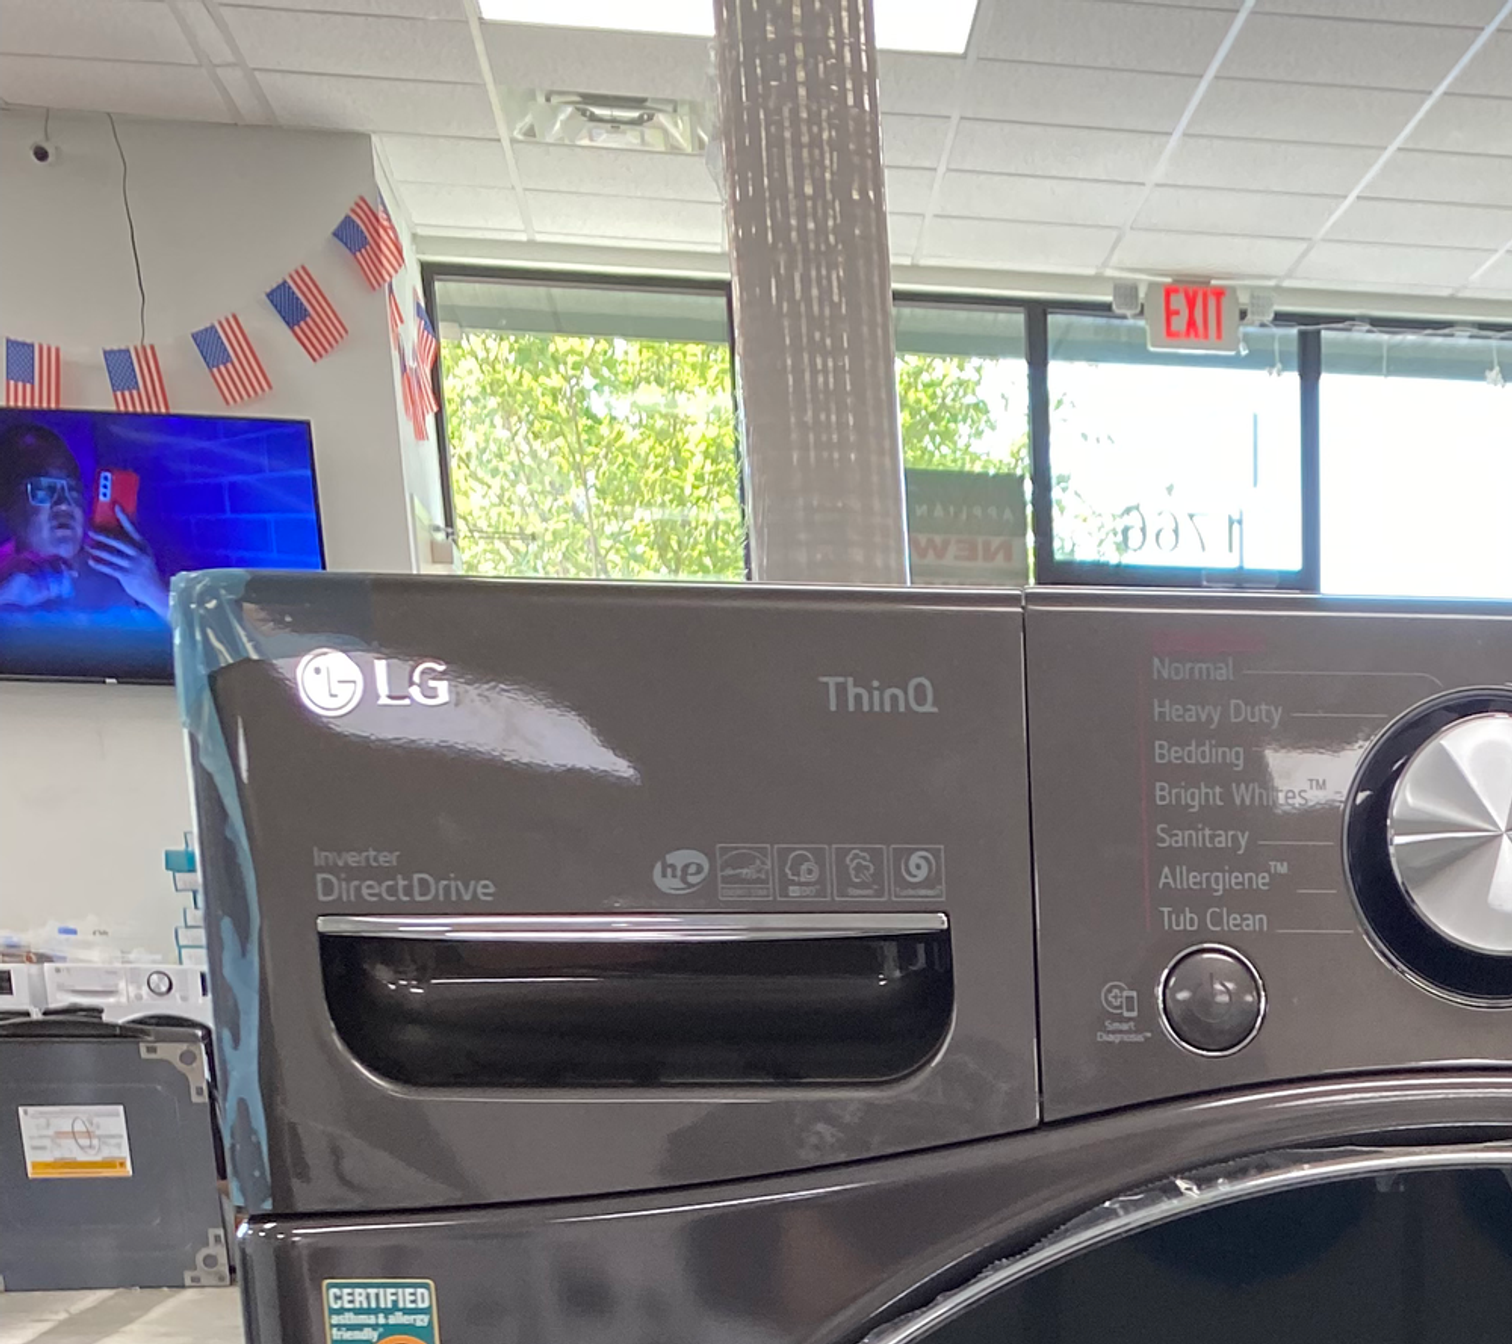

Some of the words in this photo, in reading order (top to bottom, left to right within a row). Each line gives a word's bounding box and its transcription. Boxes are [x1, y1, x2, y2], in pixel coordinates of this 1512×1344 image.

[1163, 285, 1226, 341] EXIT
[373, 655, 450, 706] LG
[1152, 657, 1234, 681] Normal
[818, 676, 939, 713] ThinQ
[1153, 699, 1221, 727] Heavy
[1230, 700, 1283, 727] Duty
[1154, 741, 1244, 768] Bedding
[1155, 783, 1223, 811] Bright
[1156, 825, 1249, 854] Sanitary
[313, 846, 401, 867] Inverter
[1160, 908, 1198, 931] Tub
[1206, 908, 1267, 932] Clean
[328, 1288, 431, 1309] CERTIFIED
[331, 1312, 376, 1325] asthma
[377, 1312, 387, 1325] &
[388, 1311, 430, 1327] allergy
